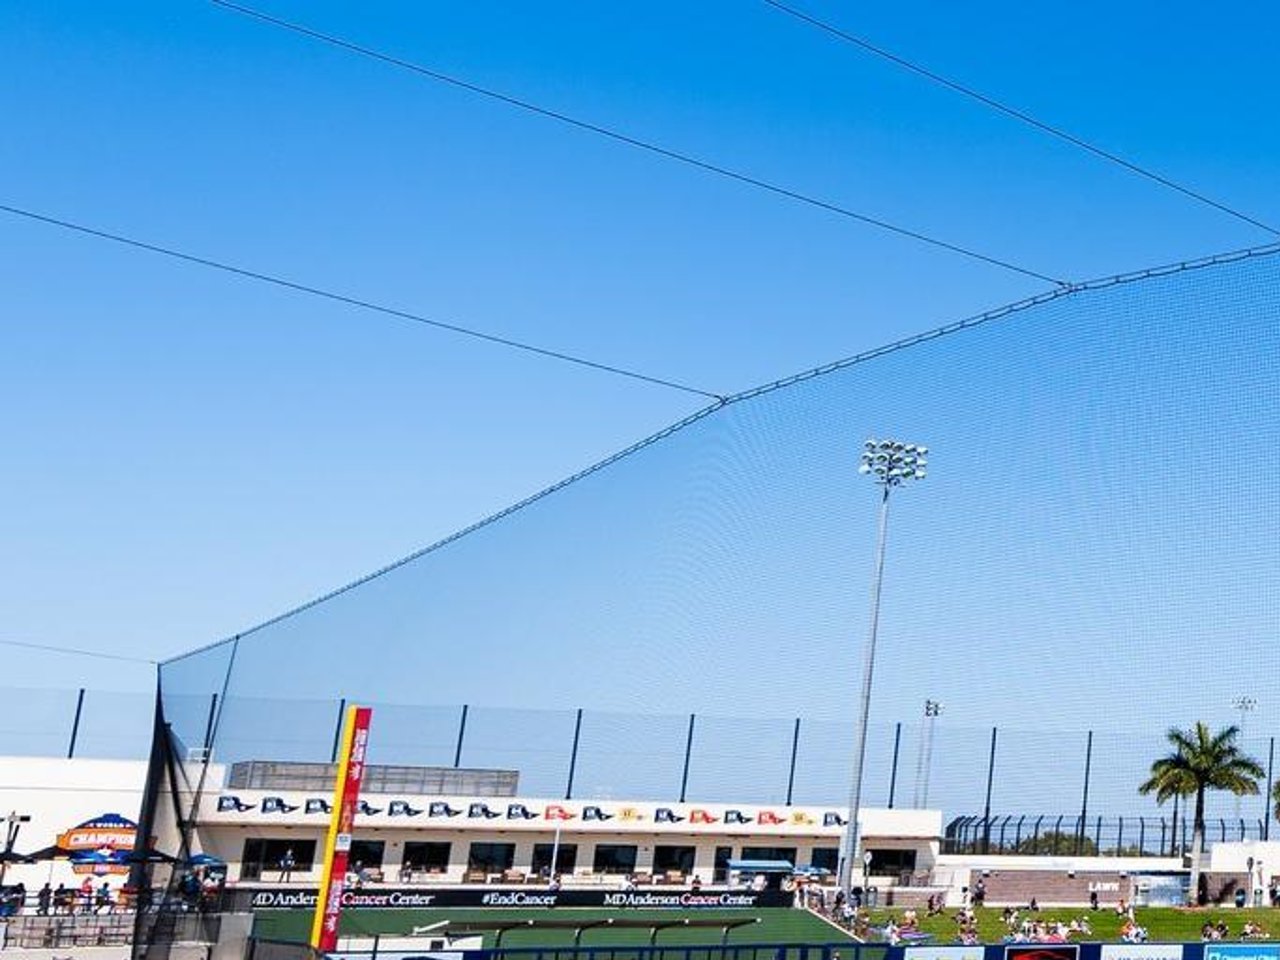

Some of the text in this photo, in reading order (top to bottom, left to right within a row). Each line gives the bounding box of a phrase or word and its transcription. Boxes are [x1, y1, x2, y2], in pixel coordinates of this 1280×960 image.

[71, 833, 136, 847] CHAMPION
[1088, 882, 1120, 891] LAWN
[273, 892, 319, 905] Ander
[343, 893, 388, 905] Cancer
[389, 893, 435, 905] Center
[482, 893, 556, 905] #EndCancer
[604, 894, 756, 905] MD Anderson Cancer Center
